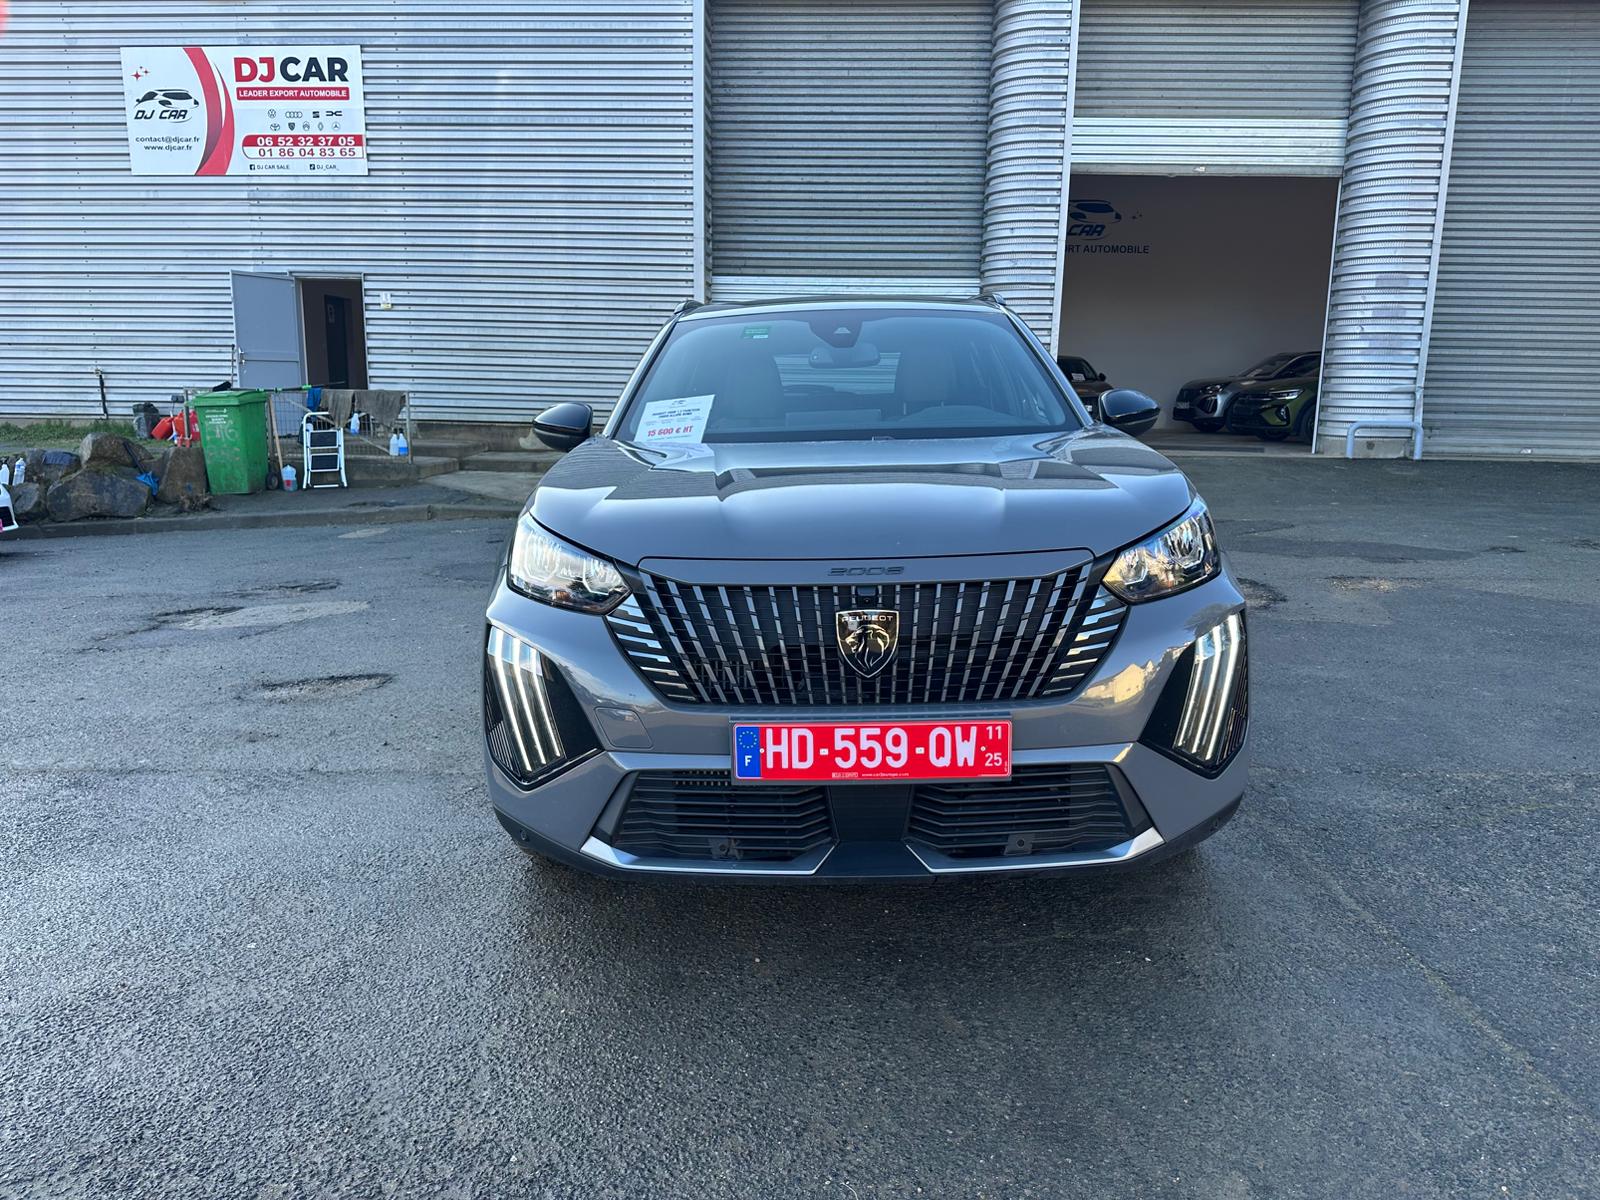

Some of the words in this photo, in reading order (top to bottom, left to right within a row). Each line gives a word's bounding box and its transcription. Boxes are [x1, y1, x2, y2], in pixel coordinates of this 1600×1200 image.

[234, 57, 276, 82] DJ
[279, 56, 349, 82] CAR
[239, 89, 268, 97] LEADER
[269, 89, 298, 97] EXPORT
[299, 89, 347, 97] AUTOMOBILE
[134, 109, 155, 120] DJ
[158, 109, 188, 120] CAR
[135, 135, 200, 144] contact@djcar.fr
[256, 136, 273, 146] 06
[277, 136, 294, 146] 52
[297, 136, 314, 146] 32
[318, 136, 334, 146] 37
[338, 136, 355, 146] 05
[144, 144, 193, 152] www.djcar.fr
[258, 148, 273, 157] 01
[278, 148, 294, 157] 86
[299, 148, 315, 157] 04
[319, 148, 335, 157] 83
[339, 148, 356, 157] 65
[1067, 224, 1106, 236] CAR
[1083, 244, 1150, 254] AUTOMOBILE
[828, 566, 905, 576] 2008
[986, 725, 1002, 740] 11
[766, 726, 977, 769] HD-559-QW
[744, 755, 753, 767] F
[984, 752, 1003, 767] 25
